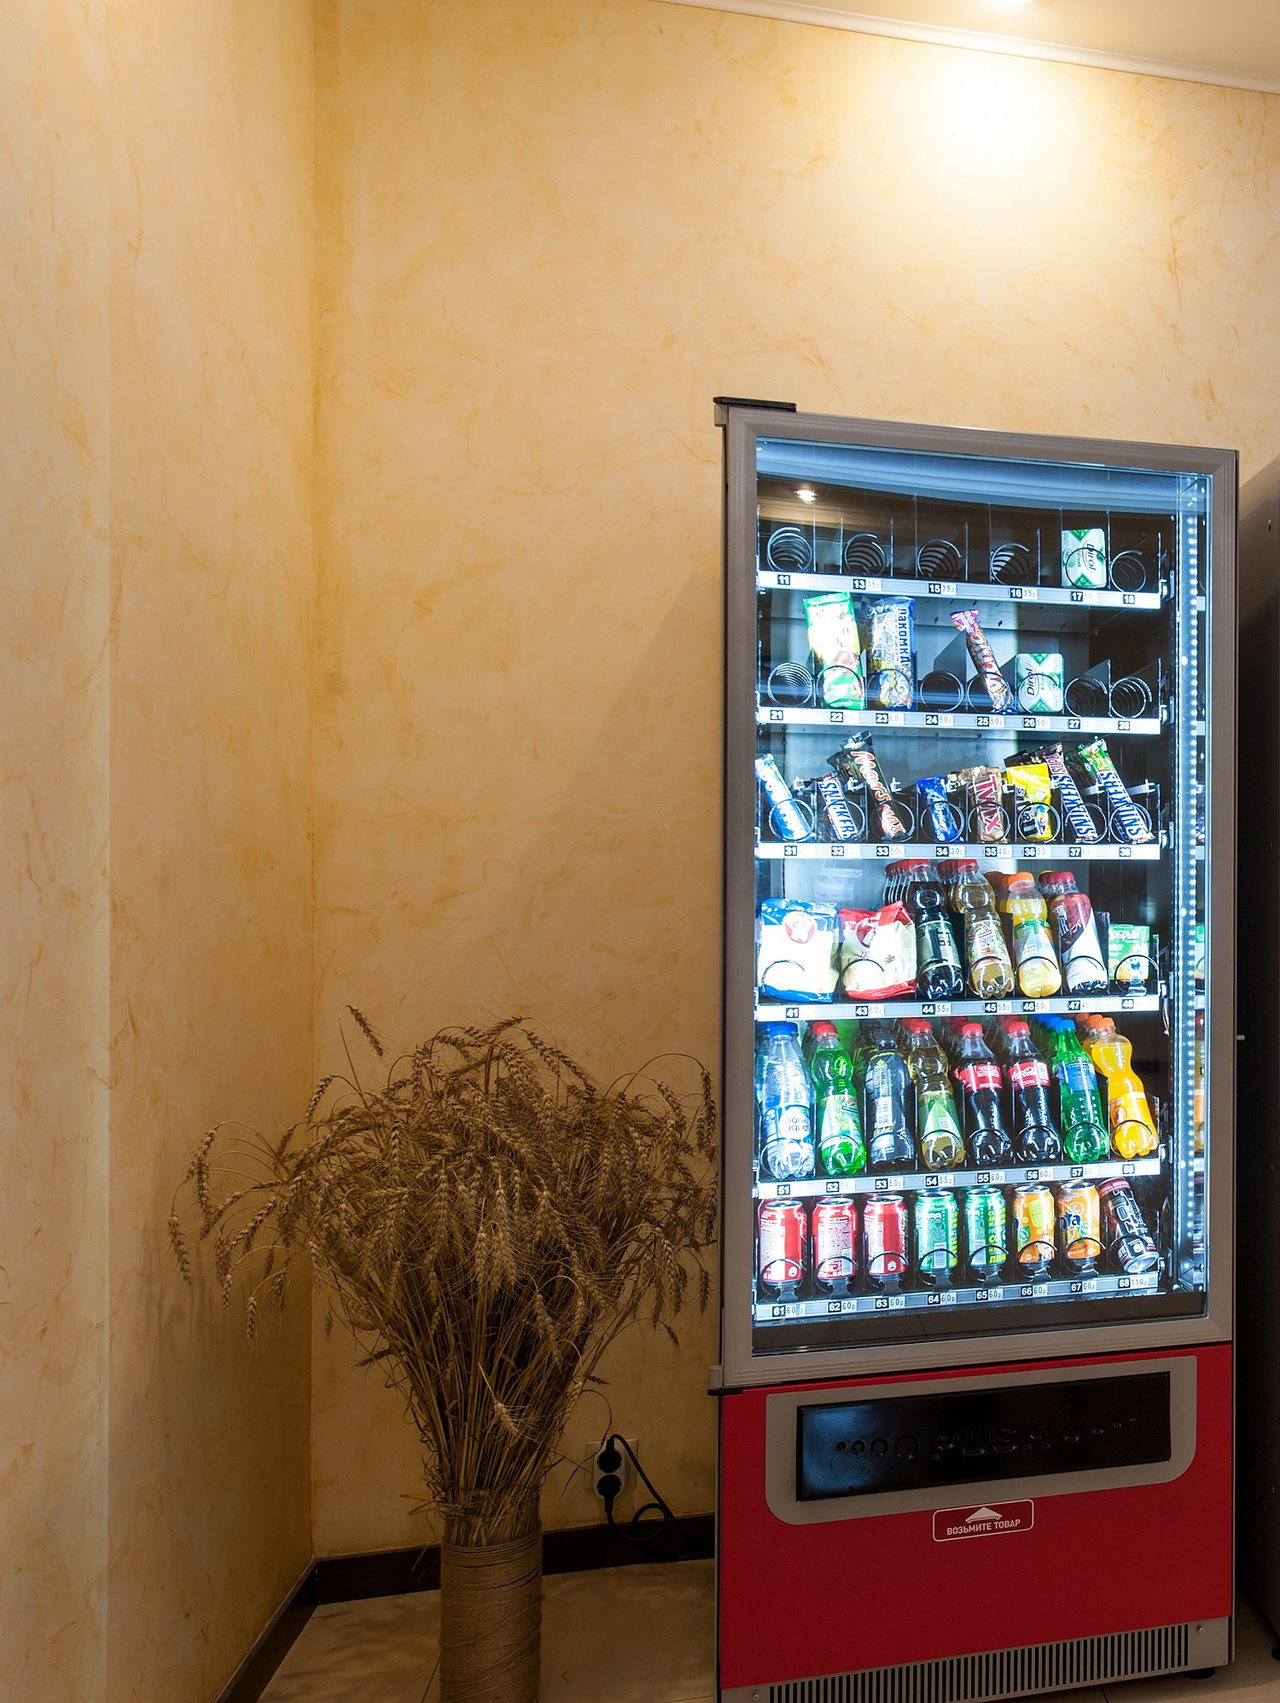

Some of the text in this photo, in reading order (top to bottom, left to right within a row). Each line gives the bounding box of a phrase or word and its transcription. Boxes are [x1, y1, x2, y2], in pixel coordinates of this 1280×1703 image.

[1087, 544, 1096, 570] Dirol
[778, 575, 790, 585] 11
[854, 580, 866, 589] 13
[929, 585, 941, 593] 15
[1011, 589, 1022, 597] 16
[1072, 592, 1083, 601] 17
[1123, 595, 1135, 603] 18
[771, 711, 783, 719] 21
[831, 713, 843, 722] 22
[876, 714, 888, 723] 23
[926, 715, 938, 724] 24
[977, 717, 989, 726] 25
[1024, 718, 1036, 727] 26
[1069, 719, 1080, 729] 27
[1119, 721, 1130, 730] 28
[1052, 776, 1095, 837] SNICKERS
[1099, 772, 1142, 836] SNICKERS
[785, 847, 797, 856] 31
[832, 847, 844, 856] 32
[877, 847, 889, 856] 33
[936, 847, 948, 856] 34
[985, 847, 997, 856] 35
[1024, 847, 1036, 856] 36
[1070, 847, 1081, 856] 37
[1120, 847, 1130, 856] 38
[985, 1003, 997, 1012] 45
[1023, 1002, 1035, 1011] 46
[1069, 1001, 1080, 1010] 47
[1122, 1000, 1134, 1009] 48
[786, 1008, 799, 1018] 41
[856, 1006, 868, 1016] 43
[922, 1005, 935, 1014] 44
[1027, 1171, 1038, 1180] 56
[1072, 1168, 1083, 1176] 57
[926, 1177, 938, 1185] 54
[978, 1173, 990, 1182] 55
[826, 1182, 839, 1192] 52
[876, 1180, 887, 1189] 53
[778, 1185, 790, 1195] 51
[1071, 1283, 1082, 1291] 67
[1119, 1279, 1130, 1287] 68
[976, 1291, 987, 1300] 65
[1022, 1287, 1032, 1296] 66
[876, 1299, 887, 1308] 63
[928, 1295, 940, 1304] 64
[773, 1307, 785, 1317] 61
[829, 1303, 841, 1312] 62
[947, 1519, 1021, 1535] ВОЗЬМИТЕ ТОВАР
